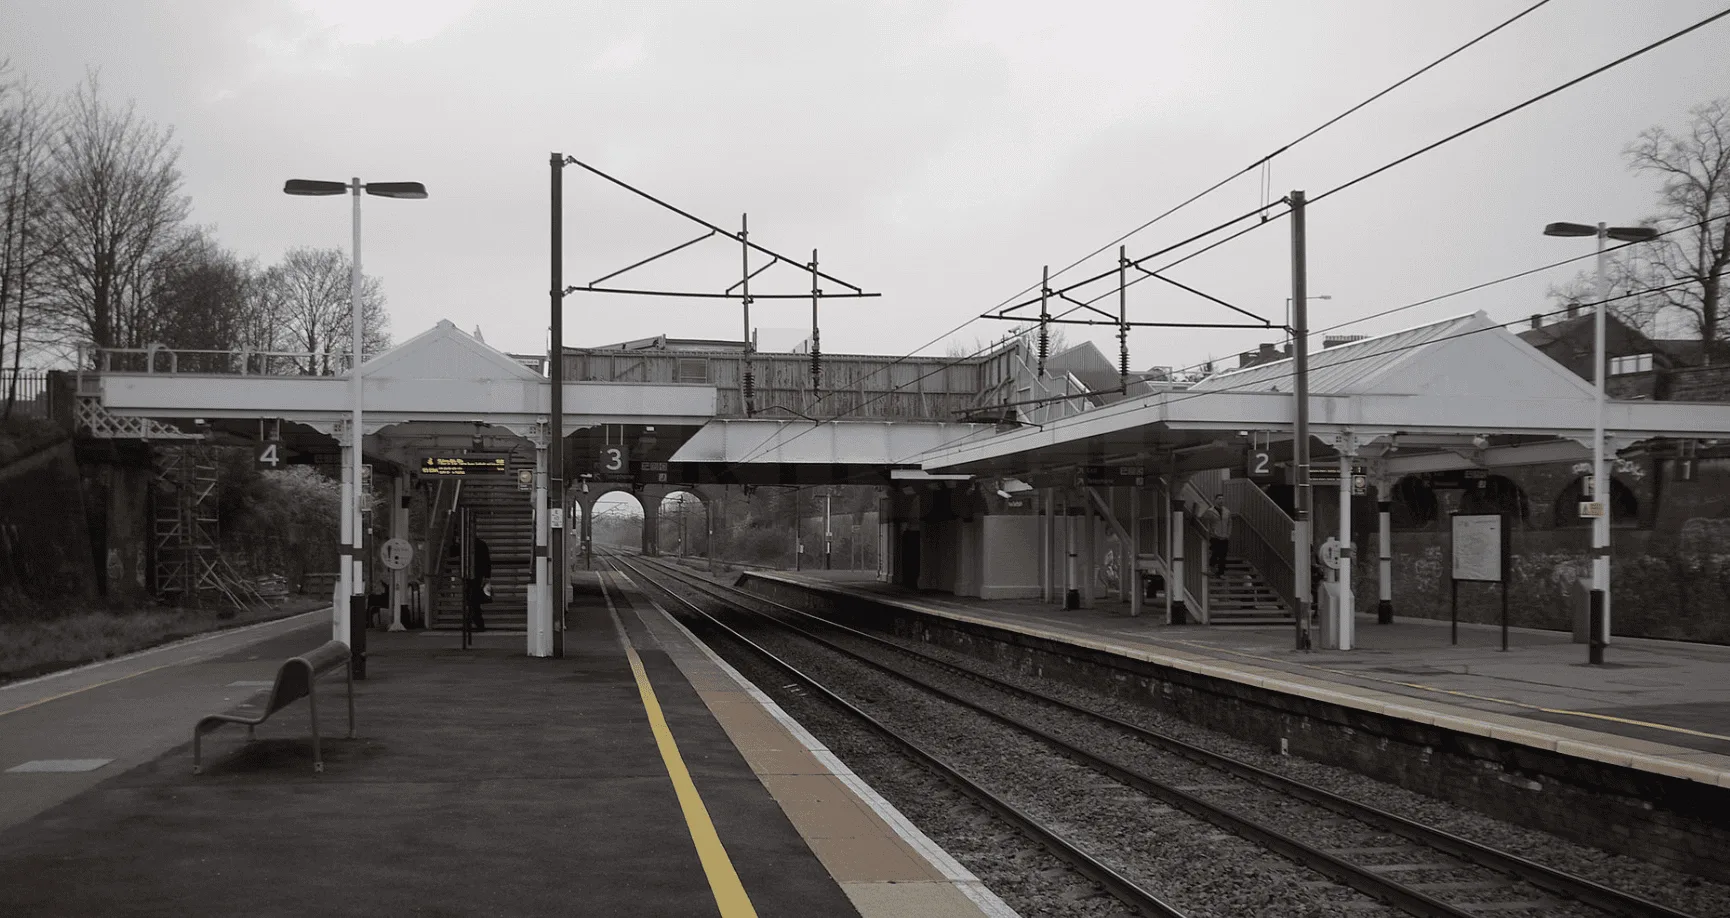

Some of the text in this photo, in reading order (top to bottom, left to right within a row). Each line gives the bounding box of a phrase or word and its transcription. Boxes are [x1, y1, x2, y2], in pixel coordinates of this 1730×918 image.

[259, 444, 280, 467] 4
[605, 448, 623, 471] 3
[1254, 453, 1270, 474] 2
[1681, 460, 1692, 480] 1
